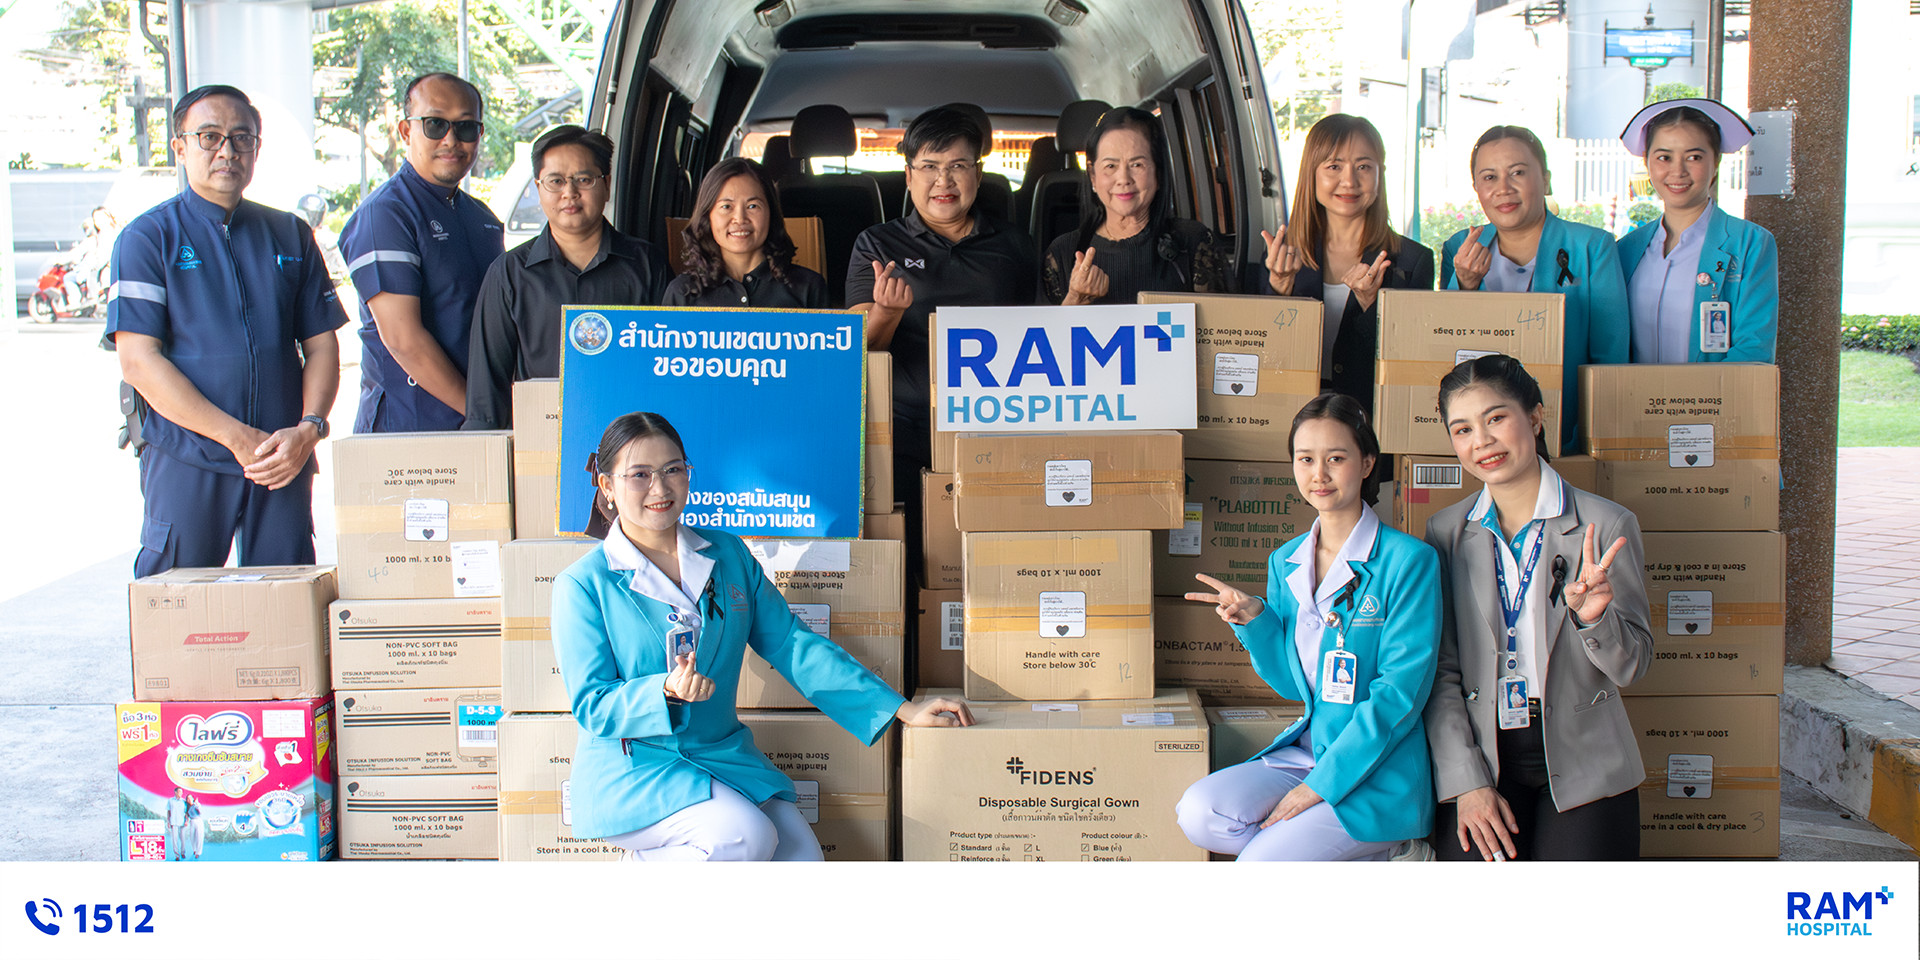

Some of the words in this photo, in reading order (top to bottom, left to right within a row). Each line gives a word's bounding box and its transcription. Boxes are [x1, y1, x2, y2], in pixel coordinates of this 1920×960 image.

[1274, 308, 1298, 330] 47
[1517, 309, 1547, 330] 45
[618, 321, 852, 351] สำนักงานเขตบางกะปิ
[1217, 328, 1242, 337] below
[1245, 330, 1268, 338] Store
[1433, 328, 1454, 336] bags
[1457, 328, 1467, 336] 10
[1214, 339, 1232, 347] with
[1234, 340, 1265, 348] Handle
[947, 325, 1136, 388] RAM
[654, 356, 786, 386] ขอขอบคุณ
[1670, 397, 1696, 405] below
[948, 394, 1137, 423] HOSPITAL
[1667, 408, 1686, 416] with
[1689, 408, 1720, 416] Handle
[1212, 416, 1226, 424] ml.
[1250, 417, 1270, 426] bags
[1414, 416, 1438, 424] Store
[1708, 487, 1729, 496] bags
[1214, 521, 1244, 533] Without
[1248, 522, 1279, 533] Infusion
[1282, 523, 1294, 534] Set
[1219, 537, 1238, 547] 1000
[1262, 538, 1271, 548] 10
[385, 556, 407, 564] 1000
[1658, 563, 1673, 571] dry
[1017, 568, 1039, 578] bags
[1041, 569, 1052, 577] 10
[1079, 569, 1101, 577] 1000
[1673, 574, 1693, 582] with
[791, 582, 810, 590] with
[813, 582, 843, 590] Handle
[1025, 651, 1056, 659] Handle
[1059, 650, 1078, 659] with
[1718, 652, 1739, 660] bags
[1023, 661, 1048, 669] Store
[1049, 661, 1076, 669] below
[1119, 663, 1132, 683] 12
[467, 706, 496, 715] D-5-S
[1646, 730, 1667, 738] bags
[777, 752, 803, 760] below
[1021, 771, 1094, 785] FIDENS
[979, 797, 1047, 810] Disposable
[1050, 797, 1101, 810] Surgical
[1104, 797, 1140, 808] Gown
[1751, 811, 1765, 834] 3
[1707, 823, 1721, 832] dry
[1723, 823, 1747, 832] place
[950, 831, 976, 839] Product
[563, 846, 573, 854] in
[581, 846, 600, 854] cool
[612, 846, 626, 854] dry
